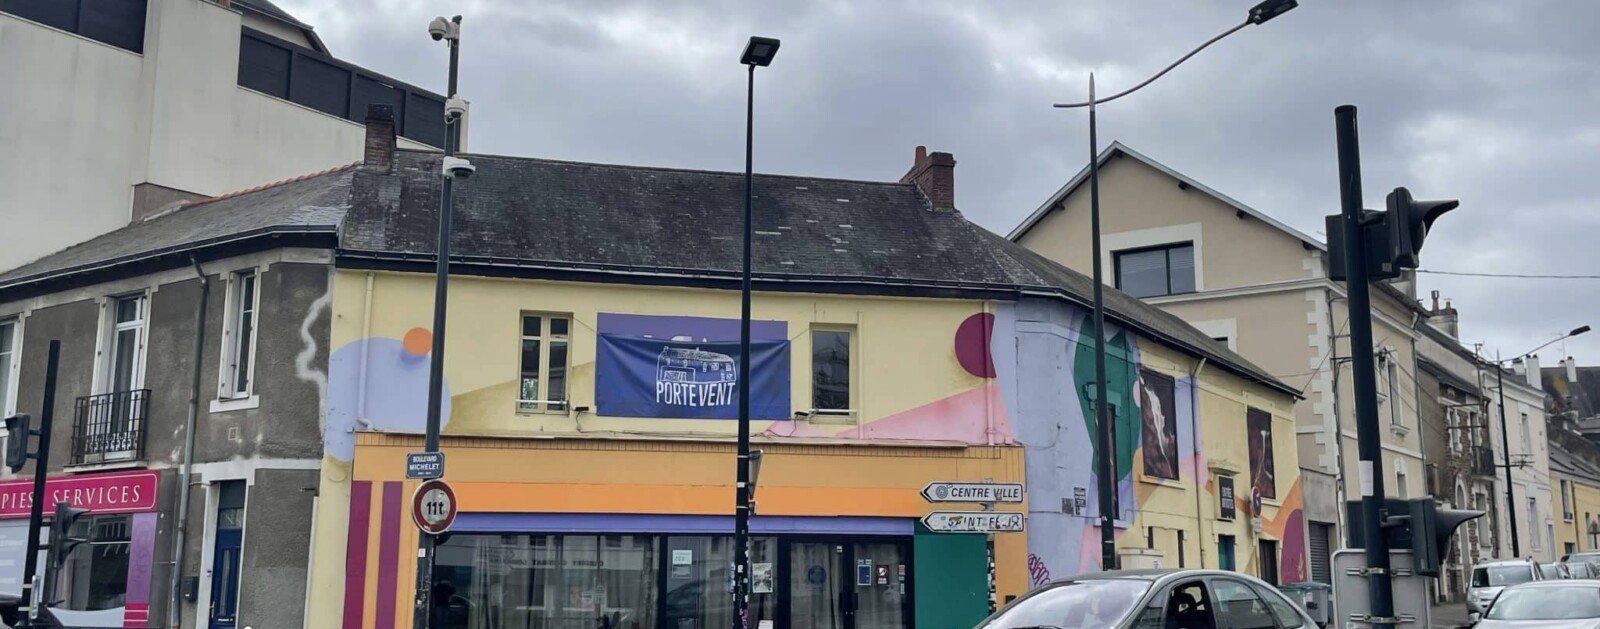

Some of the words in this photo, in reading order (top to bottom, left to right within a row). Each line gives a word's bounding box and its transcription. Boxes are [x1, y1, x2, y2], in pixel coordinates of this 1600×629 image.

[52, 485, 140, 507] SERVICES
[951, 487, 990, 498] CENTRE
[993, 488, 1019, 498] VILLE
[426, 501, 444, 515] 11t
